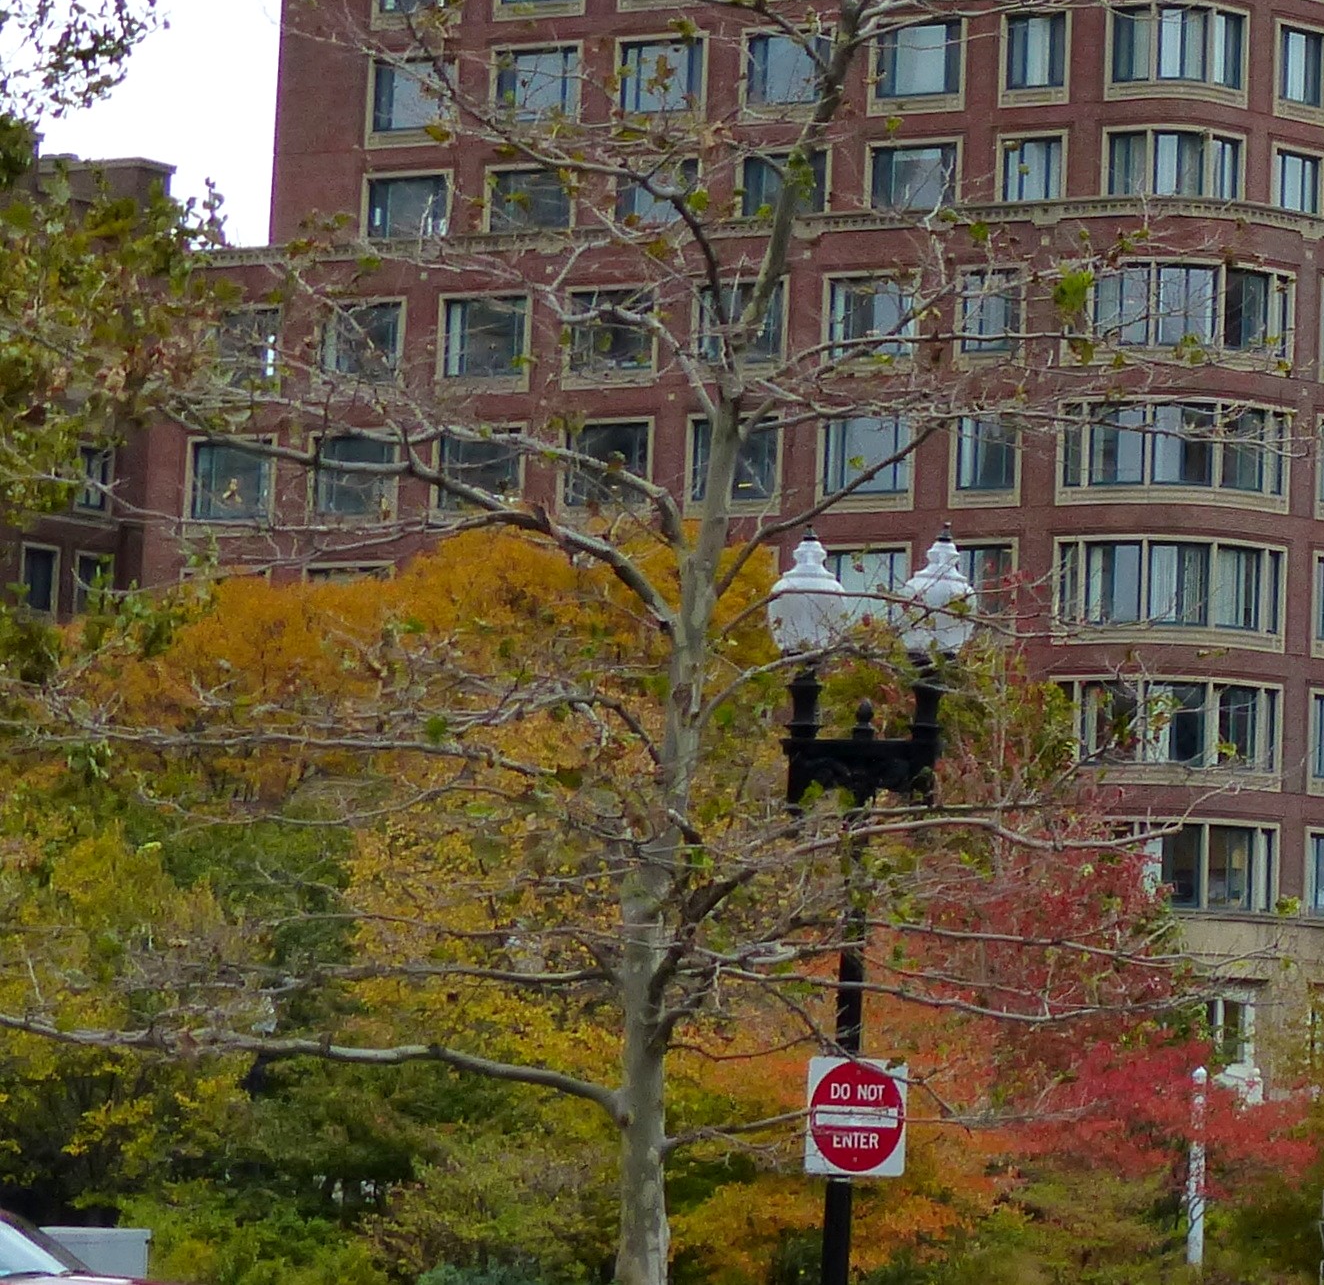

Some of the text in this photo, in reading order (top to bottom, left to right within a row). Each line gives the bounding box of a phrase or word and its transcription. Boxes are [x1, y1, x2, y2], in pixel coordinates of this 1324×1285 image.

[831, 1083, 885, 1100] DO NOT
[833, 1133, 879, 1149] ENTER
